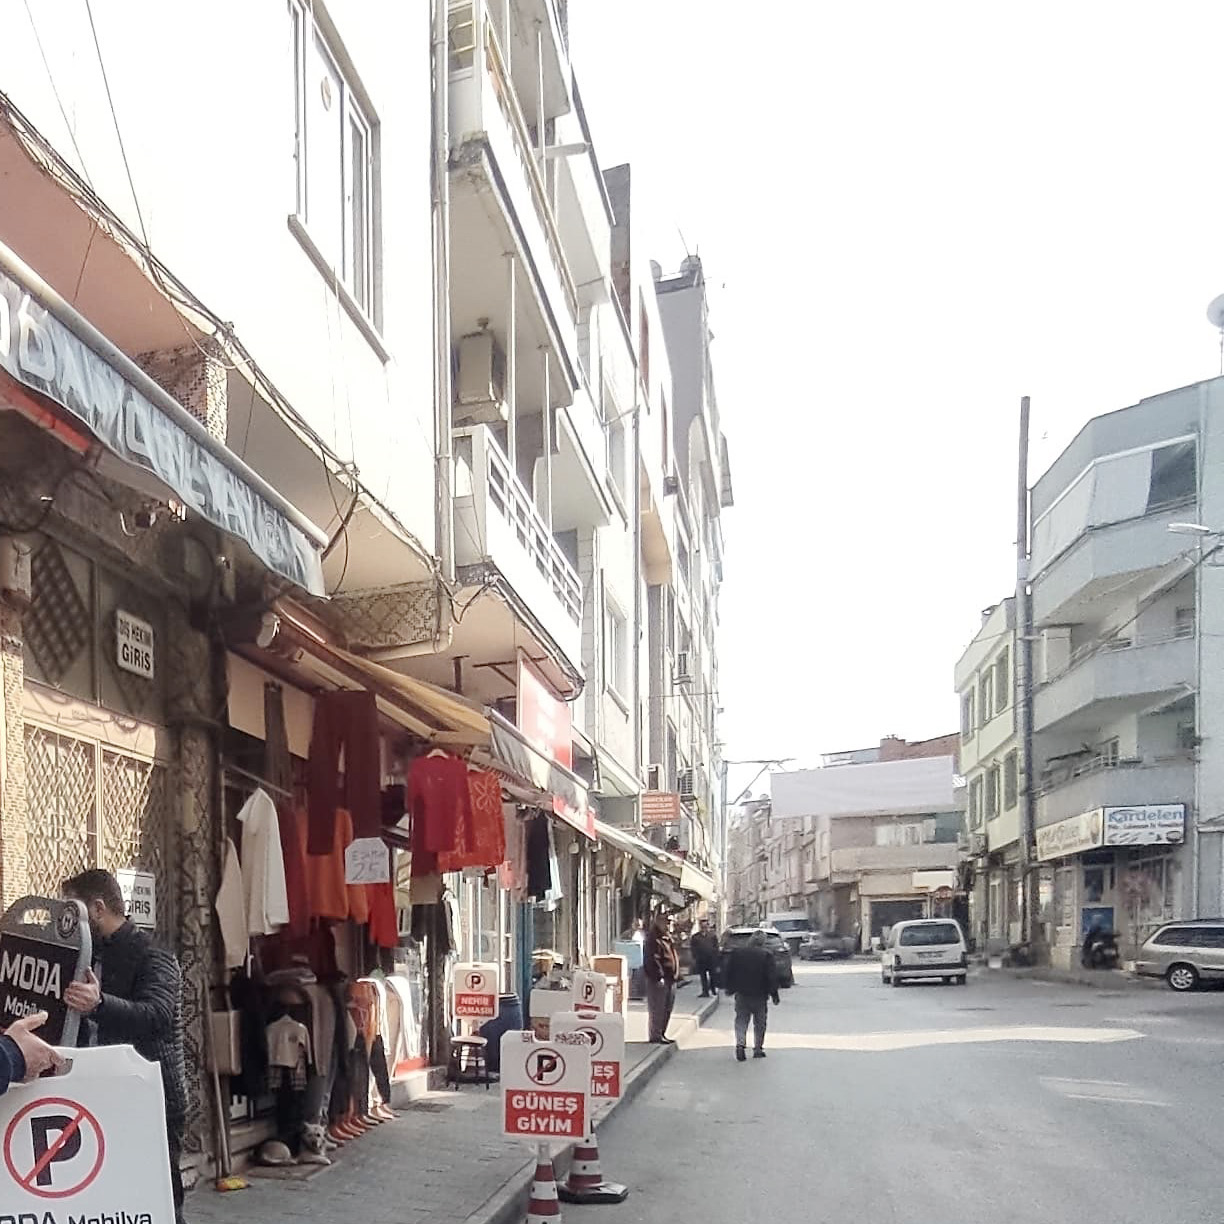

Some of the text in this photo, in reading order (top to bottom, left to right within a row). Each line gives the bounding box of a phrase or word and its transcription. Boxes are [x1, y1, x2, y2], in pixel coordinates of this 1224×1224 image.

[0, 951, 61, 1000] MODA
[512, 1092, 577, 1114] GÜNEŞ
[517, 1115, 572, 1133] GİYİM
